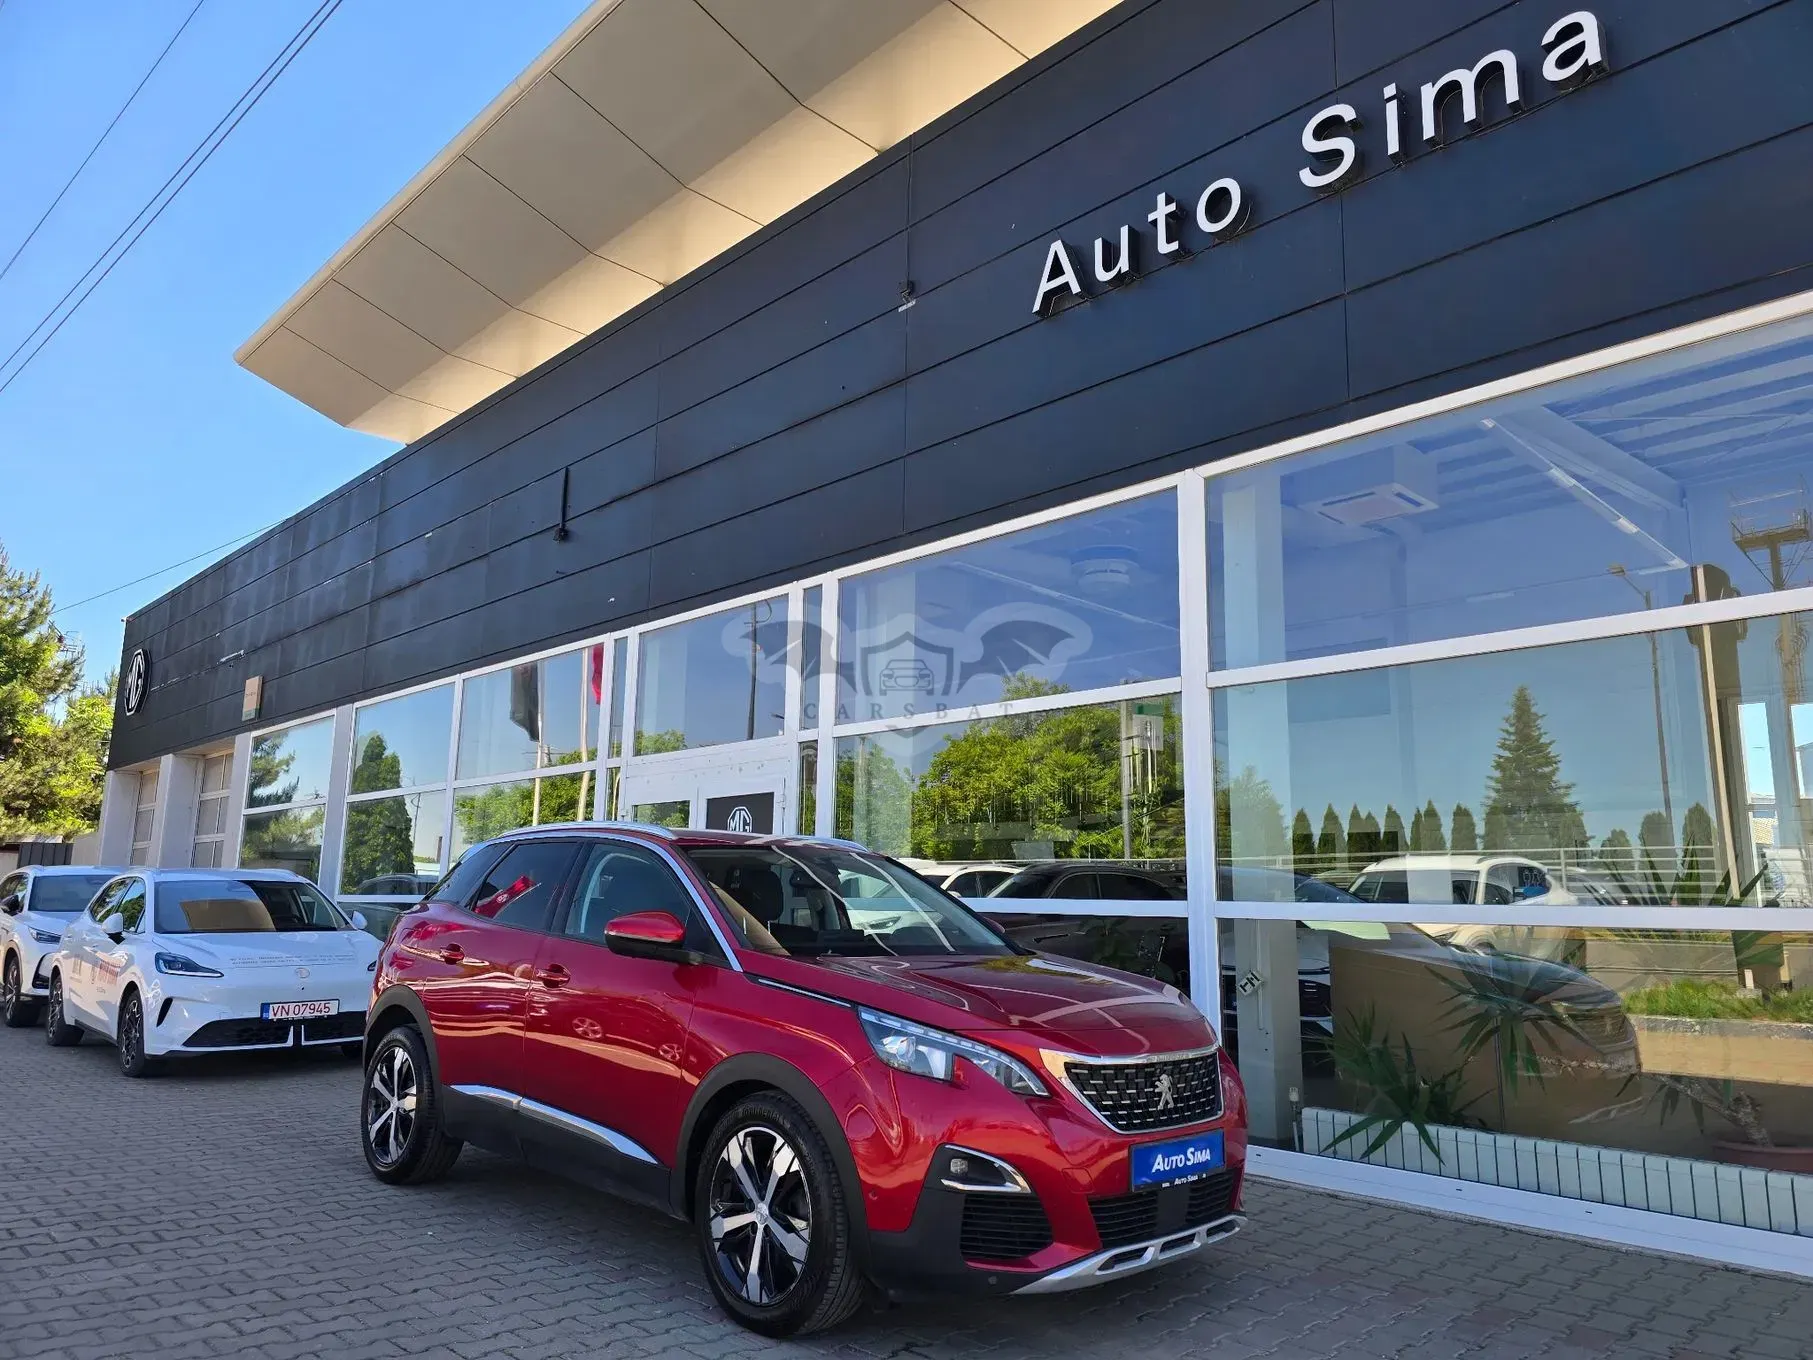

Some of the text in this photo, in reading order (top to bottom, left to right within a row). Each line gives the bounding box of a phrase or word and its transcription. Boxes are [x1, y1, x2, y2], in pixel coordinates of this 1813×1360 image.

[1031, 10, 1606, 314] Auto Sima
[125, 653, 144, 710] MG
[272, 1004, 291, 1017] VN
[293, 1002, 331, 1016] 07945
[1151, 1147, 1211, 1173] AUTO SIMA
